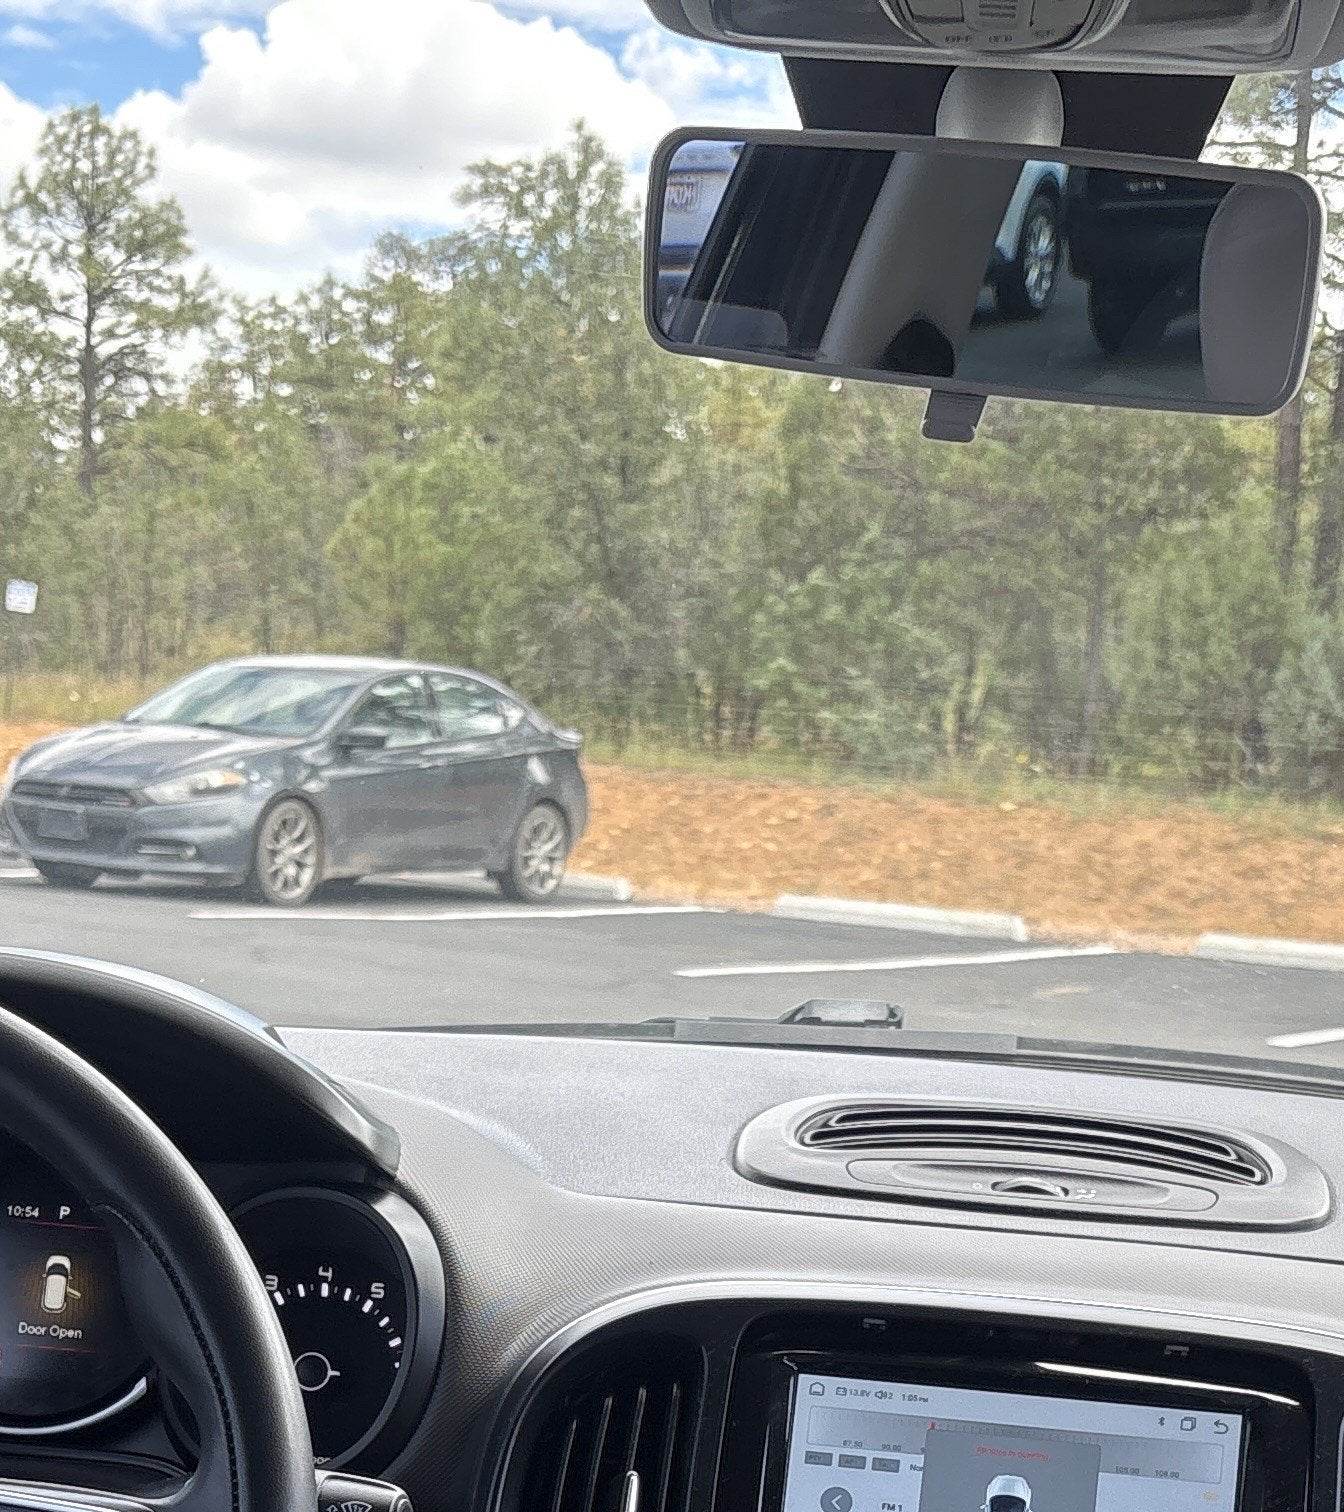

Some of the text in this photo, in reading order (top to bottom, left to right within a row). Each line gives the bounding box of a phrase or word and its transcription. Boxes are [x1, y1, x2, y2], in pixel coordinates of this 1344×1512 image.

[6, 1205, 71, 1220] 10:54 P
[318, 1265, 333, 1282] 4
[265, 1274, 279, 1291] 3
[370, 1282, 385, 1299] 5
[17, 1321, 83, 1340] Door Open
[848, 1388, 871, 1398] 13.8V
[901, 1393, 919, 1402] 1:05
[881, 1502, 903, 1512] FM 1
